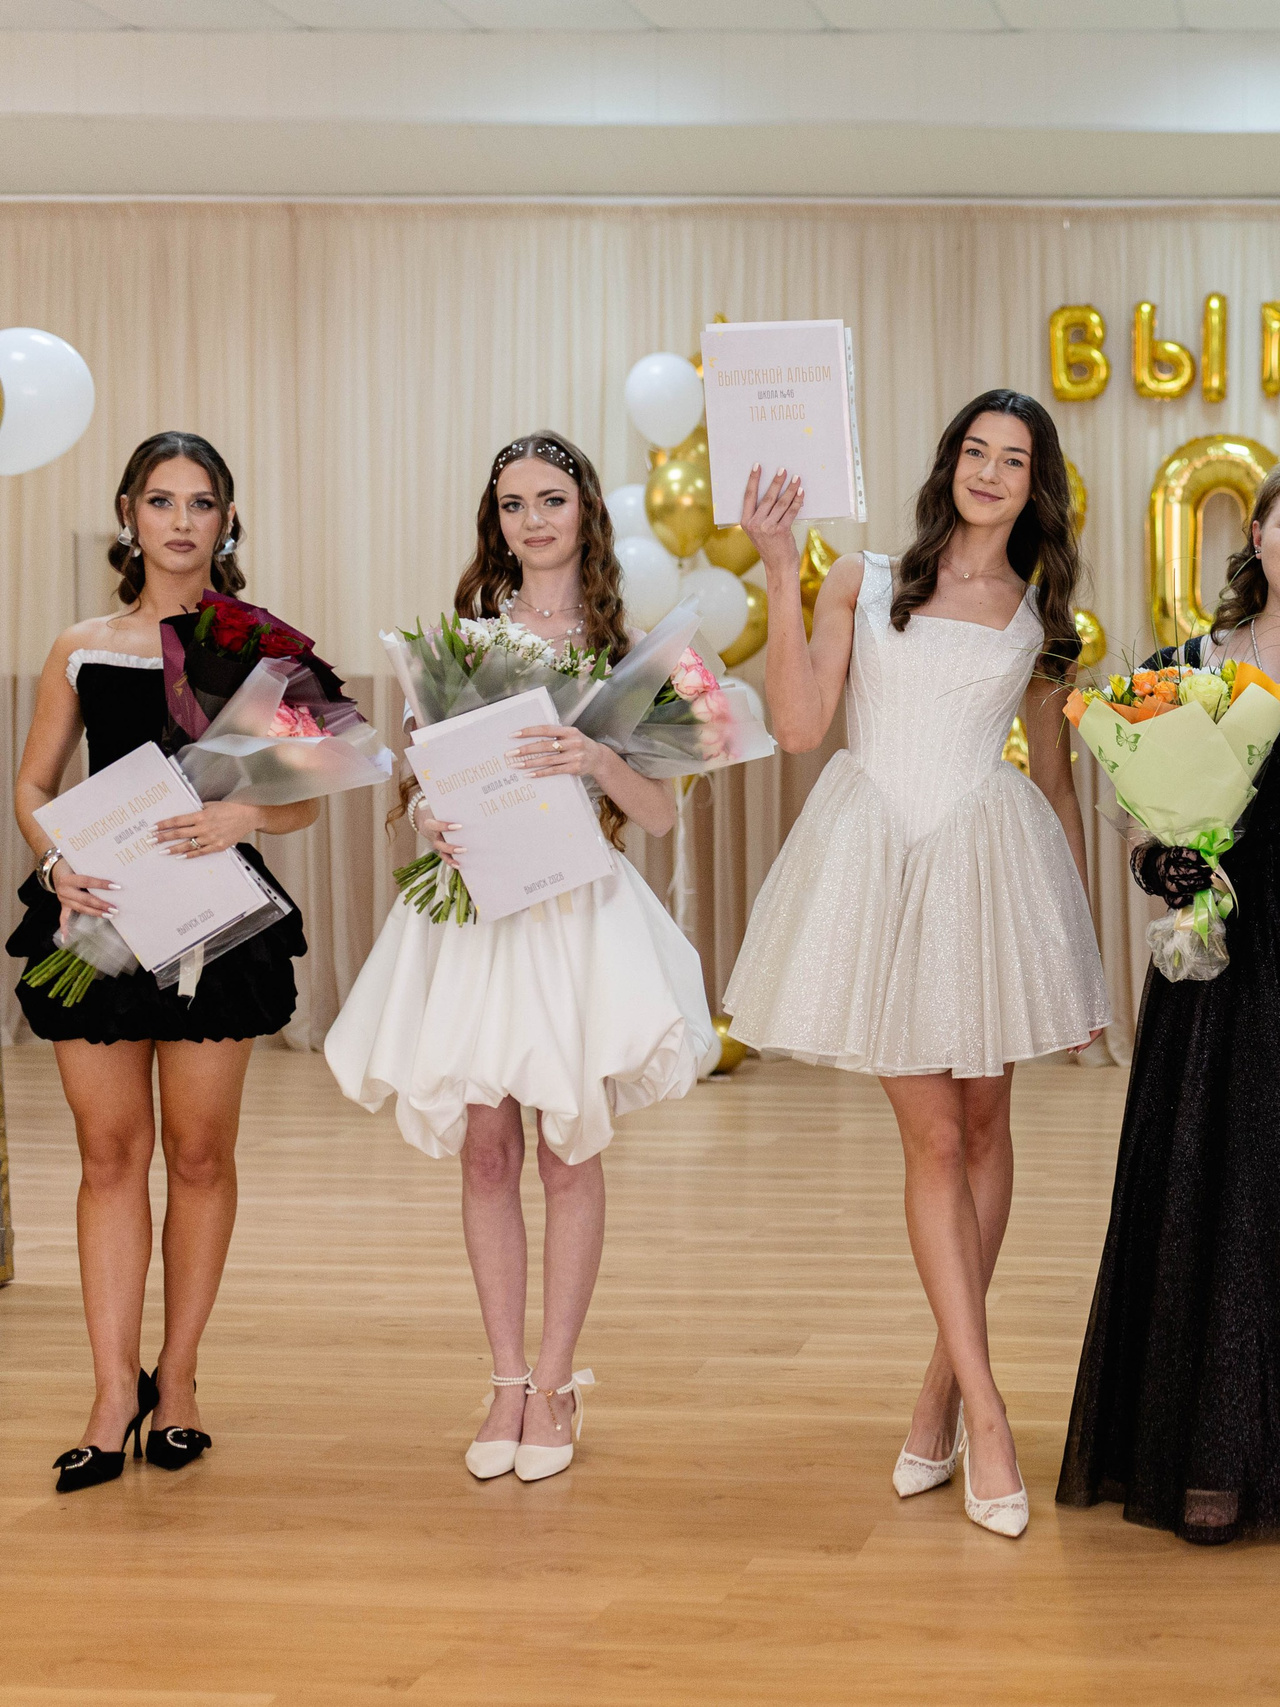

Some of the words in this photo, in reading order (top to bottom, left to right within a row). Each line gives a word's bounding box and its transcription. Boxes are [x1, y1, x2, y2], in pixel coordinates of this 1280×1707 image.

[718, 366, 782, 386] ВЫПУСКНОЙ
[787, 366, 832, 382] АЛЬБОМ
[758, 390, 778, 400] ШКОЛА
[750, 405, 766, 422] 11А
[771, 404, 806, 420] КЛАСС
[436, 757, 502, 795] ВЫПУСКНОЙ
[481, 780, 503, 794] ШКОЛА
[480, 800, 499, 817] 11А
[500, 784, 536, 810] КЛАСС
[68, 804, 131, 851] ВЫПУСКНОЙ
[128, 781, 172, 816] АЛЬБОМ
[113, 828, 134, 844] ШКОЛА
[115, 848, 136, 866] 11А
[524, 877, 548, 895] ВЫПУСК
[176, 916, 200, 936] ВЫПУСК
